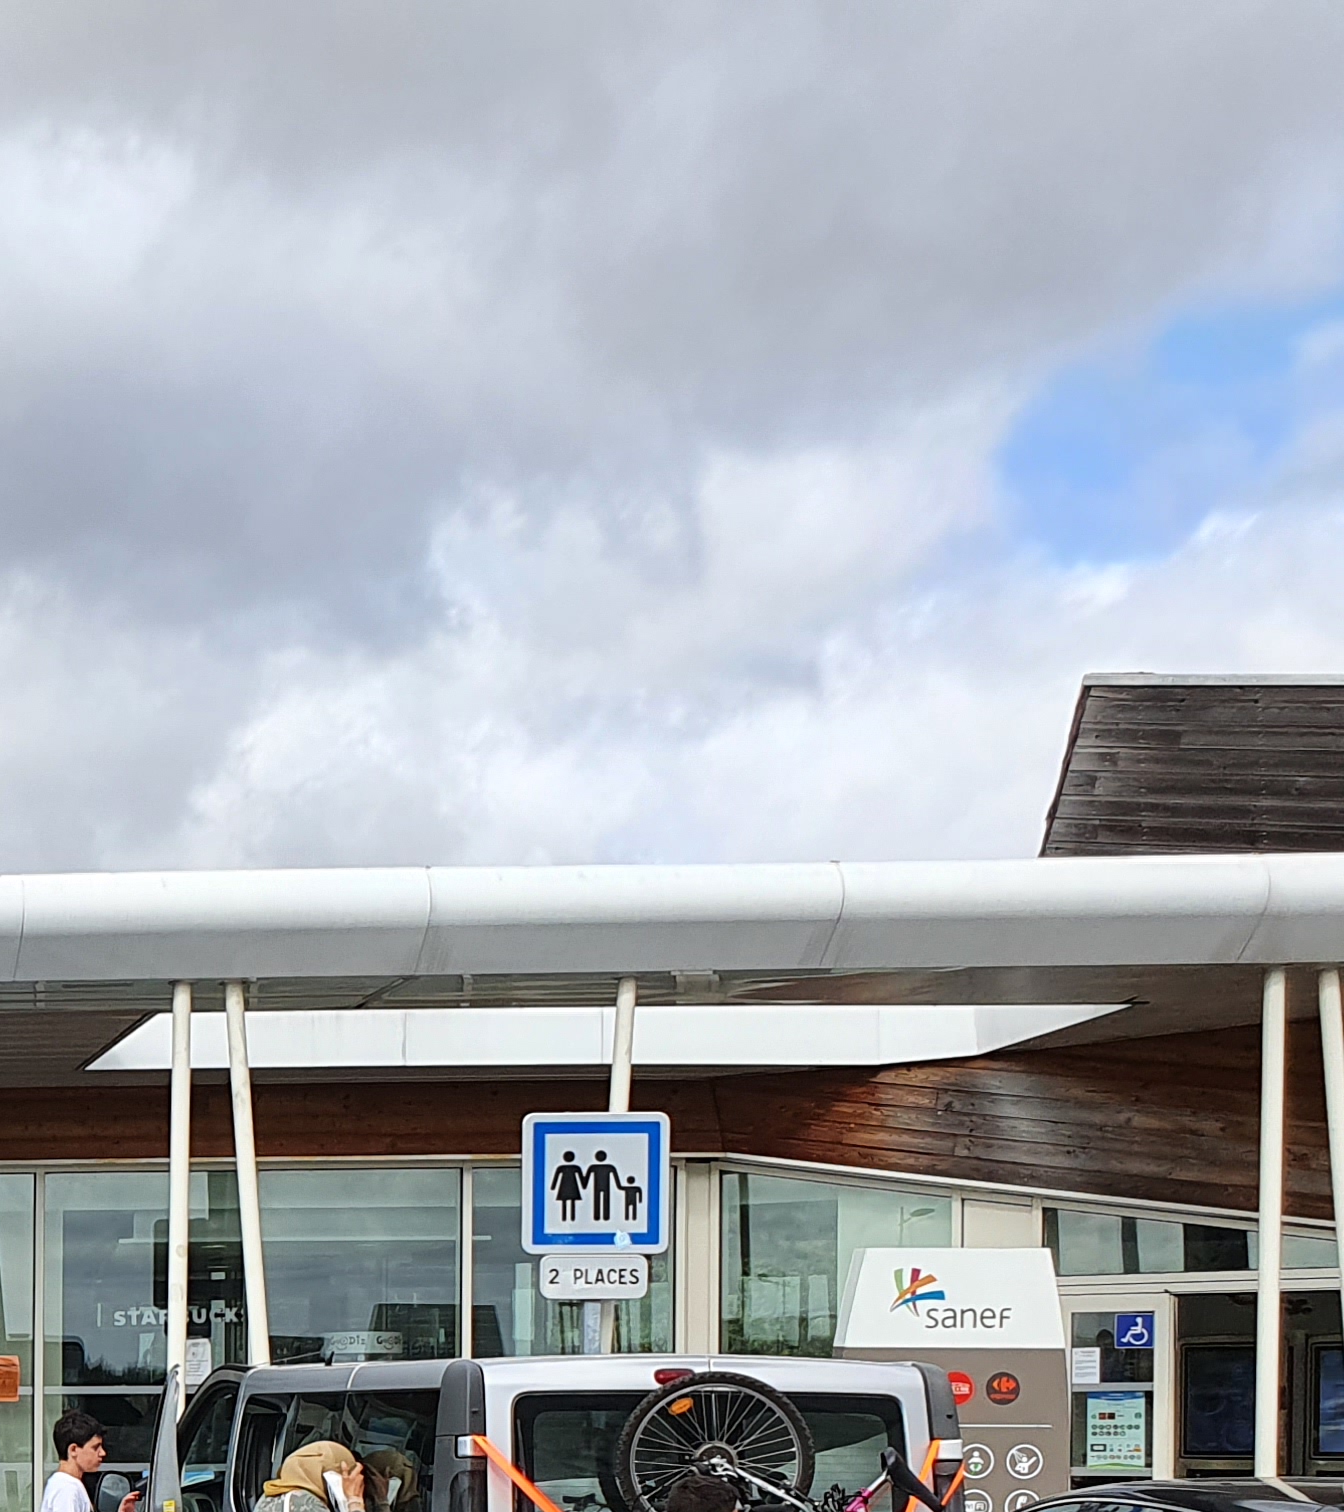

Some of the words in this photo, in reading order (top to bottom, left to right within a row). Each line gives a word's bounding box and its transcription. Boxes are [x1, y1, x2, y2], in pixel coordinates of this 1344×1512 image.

[548, 1268, 560, 1285] 2
[573, 1268, 640, 1285] PLACES
[113, 1307, 244, 1327] STAUCK
[924, 1307, 1012, 1329] sanef
